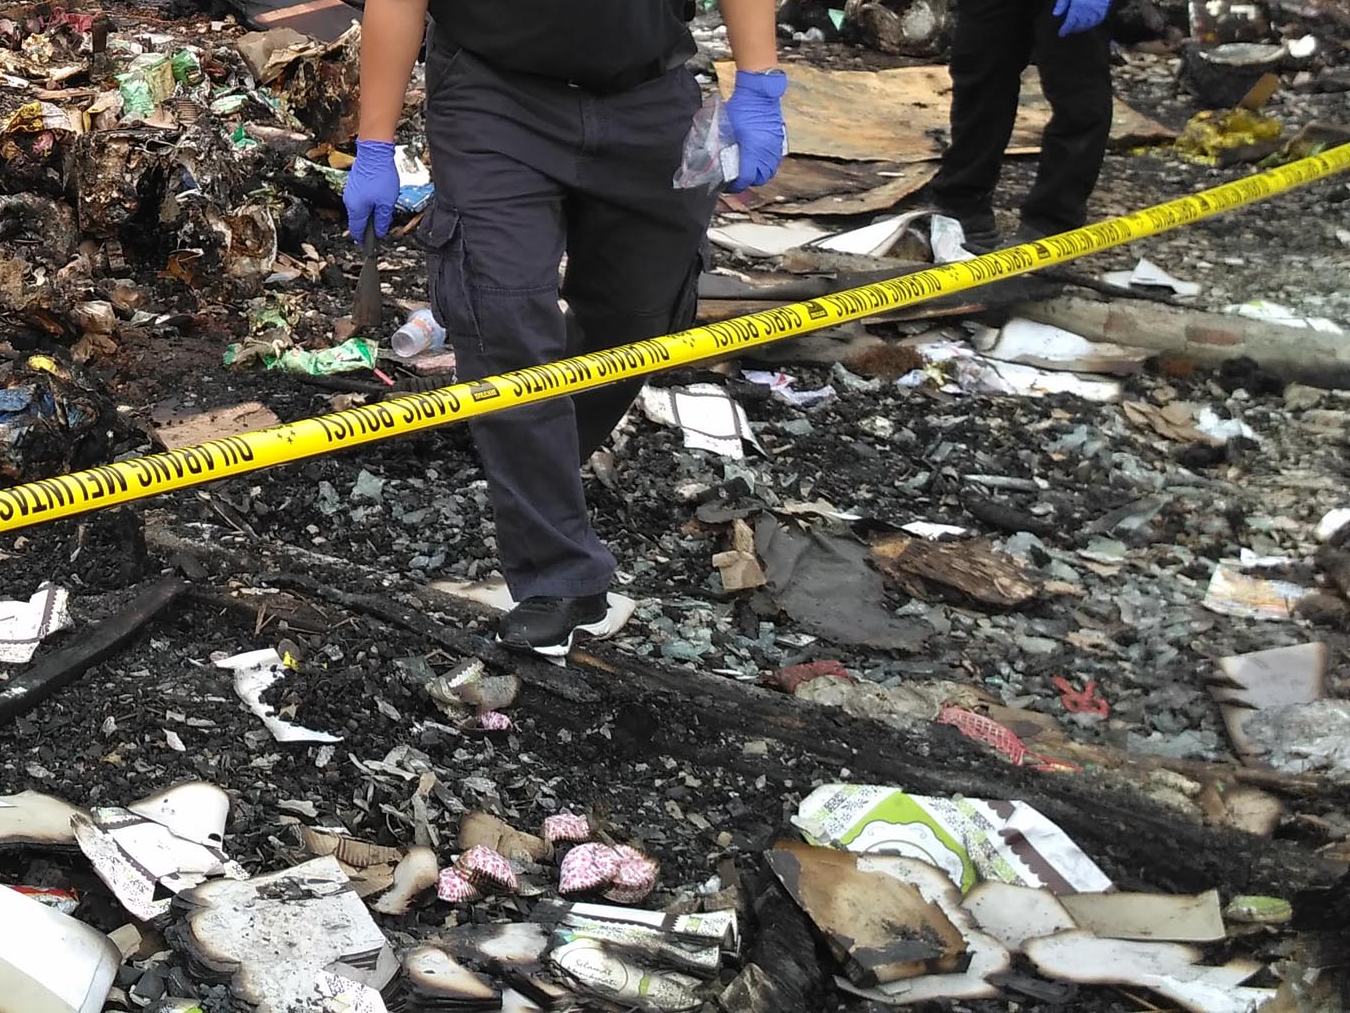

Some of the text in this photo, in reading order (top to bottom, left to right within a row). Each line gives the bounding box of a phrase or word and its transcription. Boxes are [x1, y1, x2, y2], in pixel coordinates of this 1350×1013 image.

[706, 307, 802, 348] GARIS POLISI
[507, 339, 670, 397] DILARANG MELINTAS
[316, 388, 461, 443] GARIS POLISI
[135, 436, 254, 487] DILARANG
